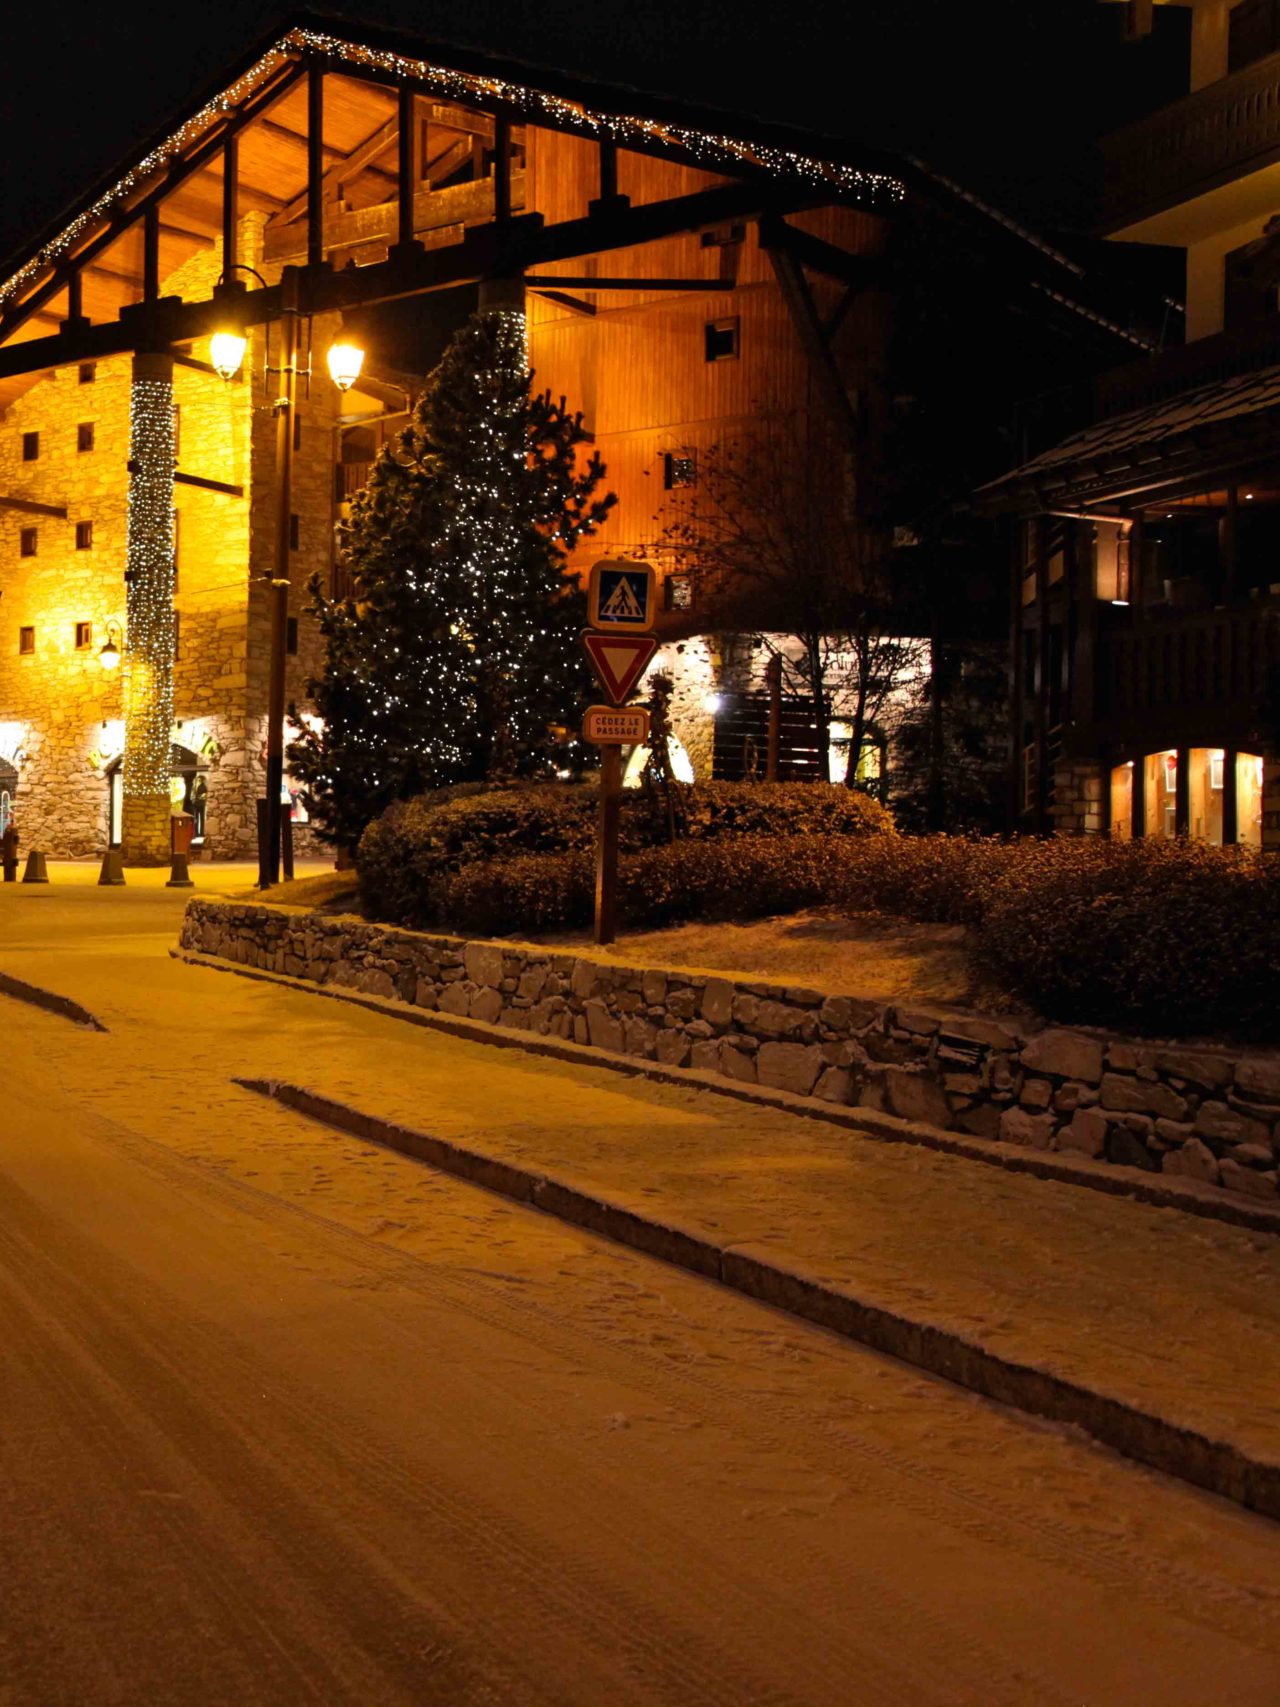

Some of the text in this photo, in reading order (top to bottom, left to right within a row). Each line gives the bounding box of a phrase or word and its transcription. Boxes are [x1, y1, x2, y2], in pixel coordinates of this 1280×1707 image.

[596, 717, 640, 726] CÉDEZ LE
[597, 727, 638, 736] PASSAGE
